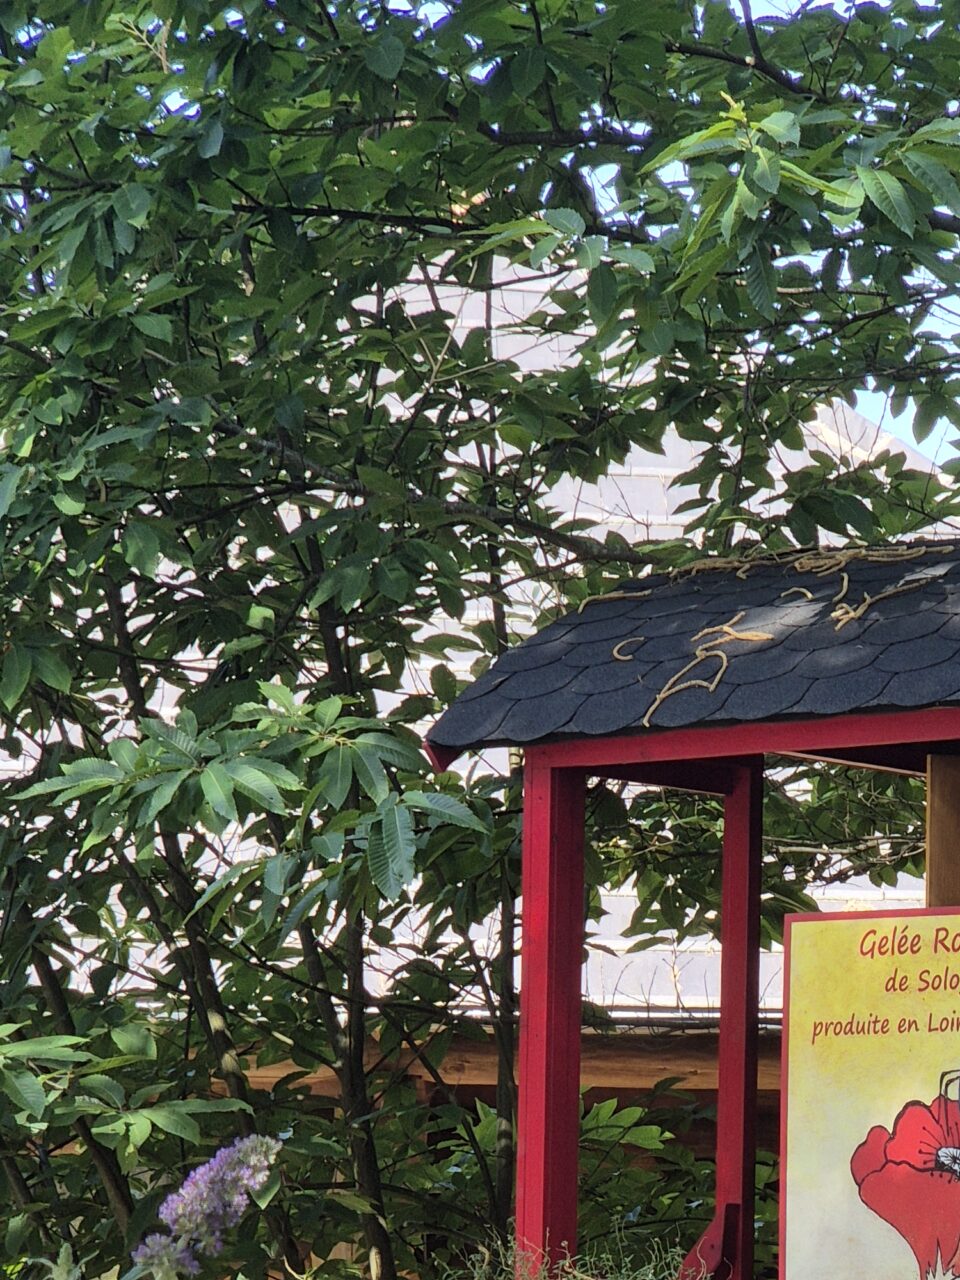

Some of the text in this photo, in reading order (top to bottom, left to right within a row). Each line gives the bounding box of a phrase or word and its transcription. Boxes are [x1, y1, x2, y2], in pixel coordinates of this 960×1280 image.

[859, 925, 922, 959] Gelée
[885, 968, 908, 992] de
[811, 1013, 890, 1045] produite
[897, 1017, 920, 1033] en
